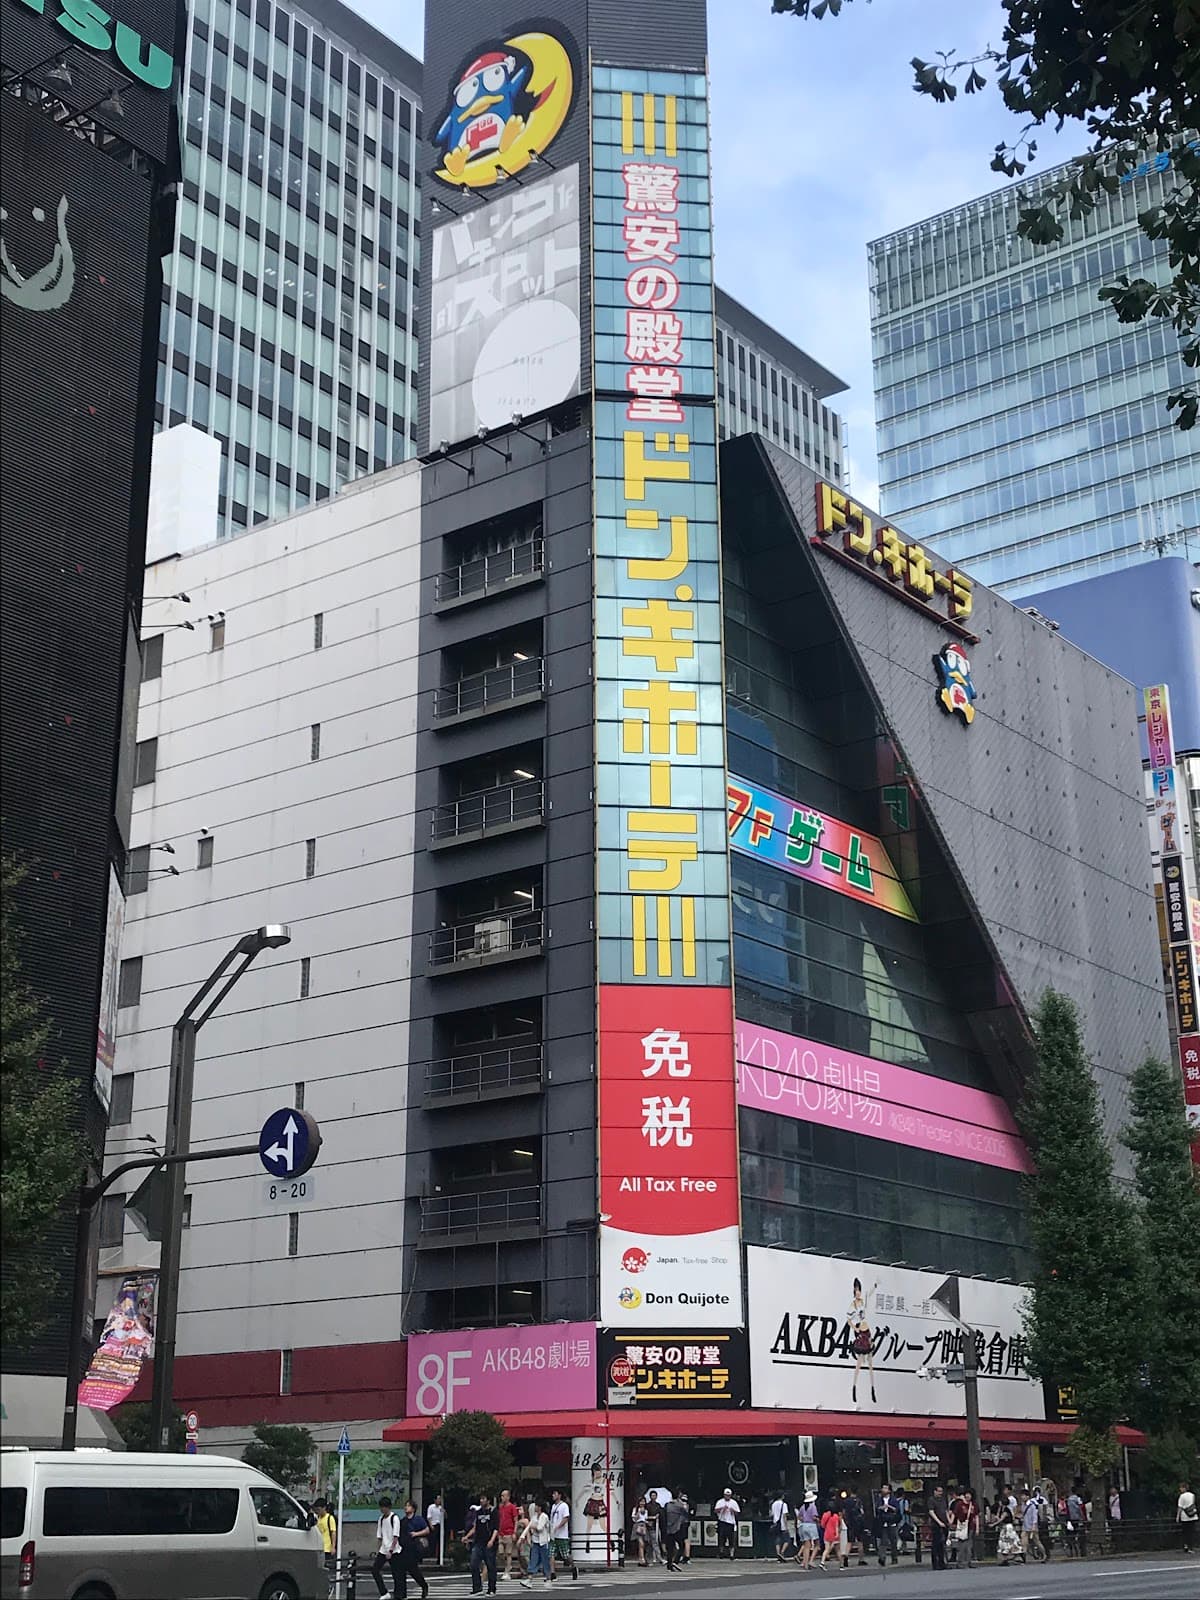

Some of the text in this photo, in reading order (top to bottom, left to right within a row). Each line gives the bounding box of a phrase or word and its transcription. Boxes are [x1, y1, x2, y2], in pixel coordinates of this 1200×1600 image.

[622, 162, 685, 422] 驚安の殿堂
[785, 807, 875, 894] ゲーム
[641, 1027, 693, 1147] 免税
[619, 1177, 718, 1192] All Tax Free
[646, 1292, 730, 1308] Don Quijote
[416, 1339, 590, 1416] 8F AKB48劇場
[625, 1346, 721, 1365] 驚安の殿堂
